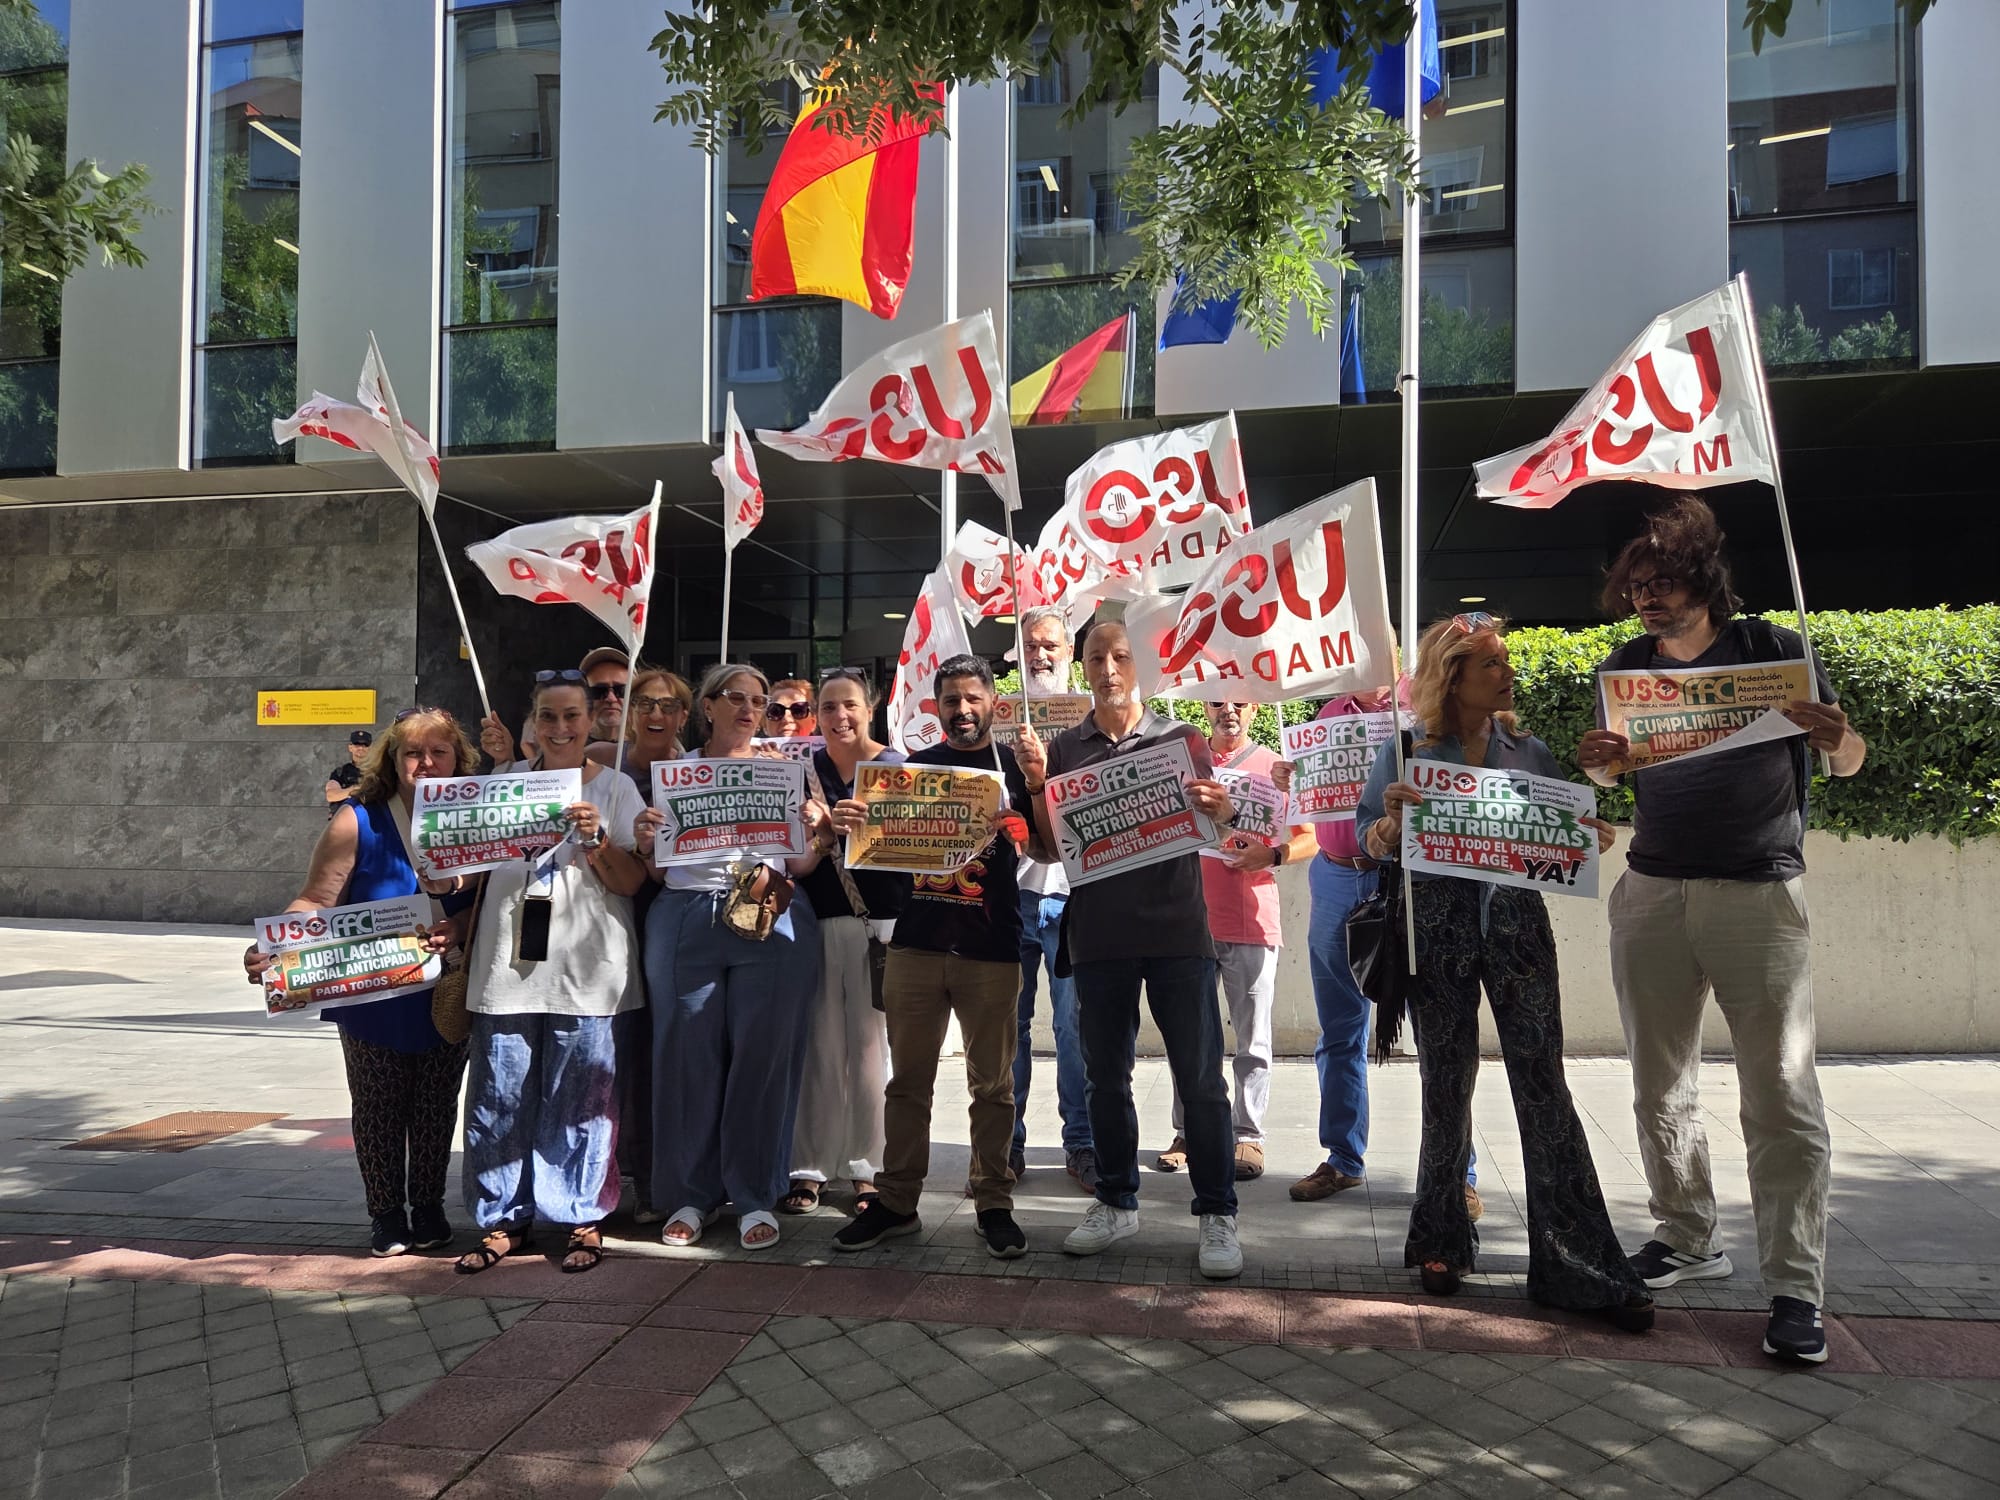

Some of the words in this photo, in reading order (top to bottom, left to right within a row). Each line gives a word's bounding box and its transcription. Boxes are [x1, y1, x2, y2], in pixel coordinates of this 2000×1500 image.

[1737, 674, 1782, 683] Federación
[1738, 684, 1775, 693] Atención
[1785, 682, 1794, 690] la
[1613, 678, 1680, 702] USO
[1739, 692, 1787, 702] Ciudadanía
[1288, 725, 1328, 750] USO
[1136, 753, 1169, 766] Federación
[1303, 747, 1377, 775] MEJORA
[661, 764, 713, 787] USO
[862, 769, 915, 790] USO
[1300, 766, 1371, 791] RETRIBUT
[1413, 766, 1478, 794] USO
[1532, 781, 1571, 792] Federación
[423, 782, 480, 802] USO
[1050, 773, 1099, 803] USO
[1317, 785, 1340, 797] TODO
[1343, 783, 1354, 795] EL
[1532, 788, 1565, 799] Atención
[677, 790, 784, 813] HOMOLOGACIÓN
[871, 803, 968, 819] CUMPLIMIENTO
[1073, 779, 1179, 828] HOMOLOGACIÓN
[1304, 801, 1315, 811] DE
[1315, 798, 1330, 809] LA
[1533, 796, 1575, 808] Ciudadanía
[437, 804, 550, 829] MEJORAS
[682, 807, 783, 827] RETRIBUTIVA
[1081, 794, 1182, 842] RETRIBUTIVA
[1431, 801, 1562, 827] MEJORAS
[429, 818, 566, 847] RETRIBUTIVAS
[707, 825, 737, 835] ENTRE
[884, 818, 955, 834] INMEDIATO
[1111, 827, 1142, 846] ENTRE
[1422, 815, 1584, 848] RETRIBUTIVAS
[432, 848, 461, 859] PARA
[463, 844, 492, 856] TODO
[494, 841, 506, 850] EL
[507, 834, 555, 847] PERSONAL
[679, 830, 786, 851] ADMINISTRACIONES
[870, 838, 881, 847] DE
[884, 838, 911, 847] TODOS
[913, 838, 929, 847] LOS
[931, 838, 975, 849] ACUERDOS
[1086, 821, 1193, 869] ADMINISTRACIONES
[1424, 835, 1455, 847] PARA
[1459, 837, 1491, 851] TODO
[1494, 841, 1507, 853] EL
[1511, 843, 1570, 862] PERSONAL
[442, 856, 459, 867] DE
[462, 854, 479, 864] LA
[1434, 848, 1452, 860] DE
[1456, 850, 1474, 863] LA
[1479, 854, 1514, 870] AGE,
[1522, 857, 1582, 887] YA!
[373, 905, 409, 915] Federación
[374, 913, 402, 924] Atención
[265, 917, 328, 944] USO
[303, 937, 400, 971] JUBILACIÓN
[291, 967, 345, 987] PARCIAL
[345, 952, 415, 976] ANTICIPADA
[315, 984, 348, 997] PARA
[349, 975, 389, 992] TODOS
